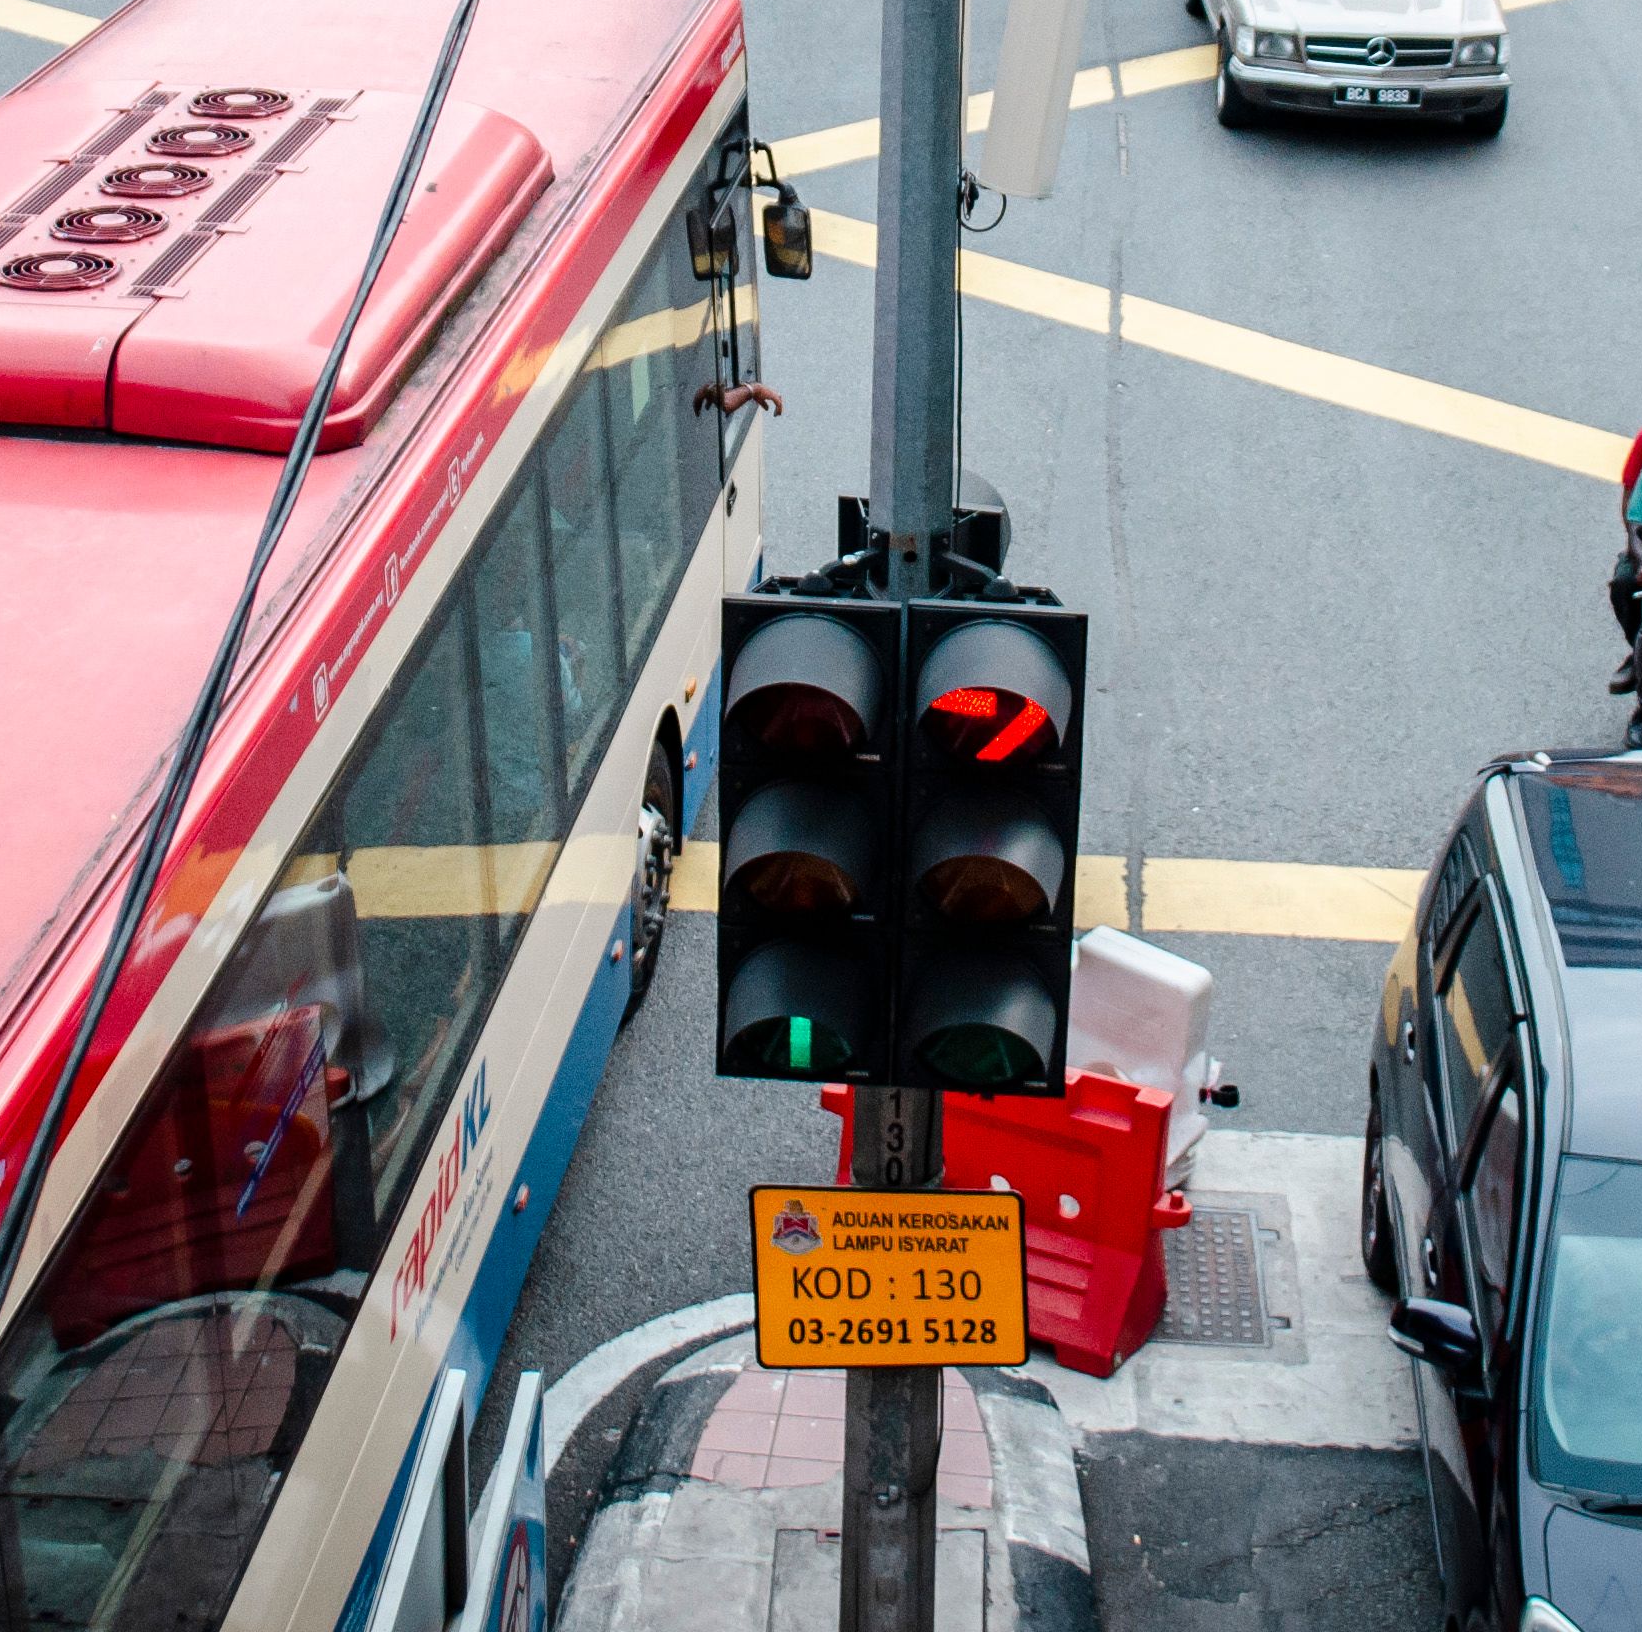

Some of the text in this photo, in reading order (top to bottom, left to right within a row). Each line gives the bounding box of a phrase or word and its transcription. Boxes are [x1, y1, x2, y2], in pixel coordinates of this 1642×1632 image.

[885, 1088, 905, 1187] 130
[390, 1055, 492, 1345] rapidKL
[832, 1211, 1010, 1231] ADUAN KEROSAKAN
[833, 1234, 969, 1254] LAMPU ISYARAT
[792, 1266, 872, 1300] KOD
[912, 1268, 982, 1301] 130
[788, 1318, 997, 1345] 03-2691 5128
